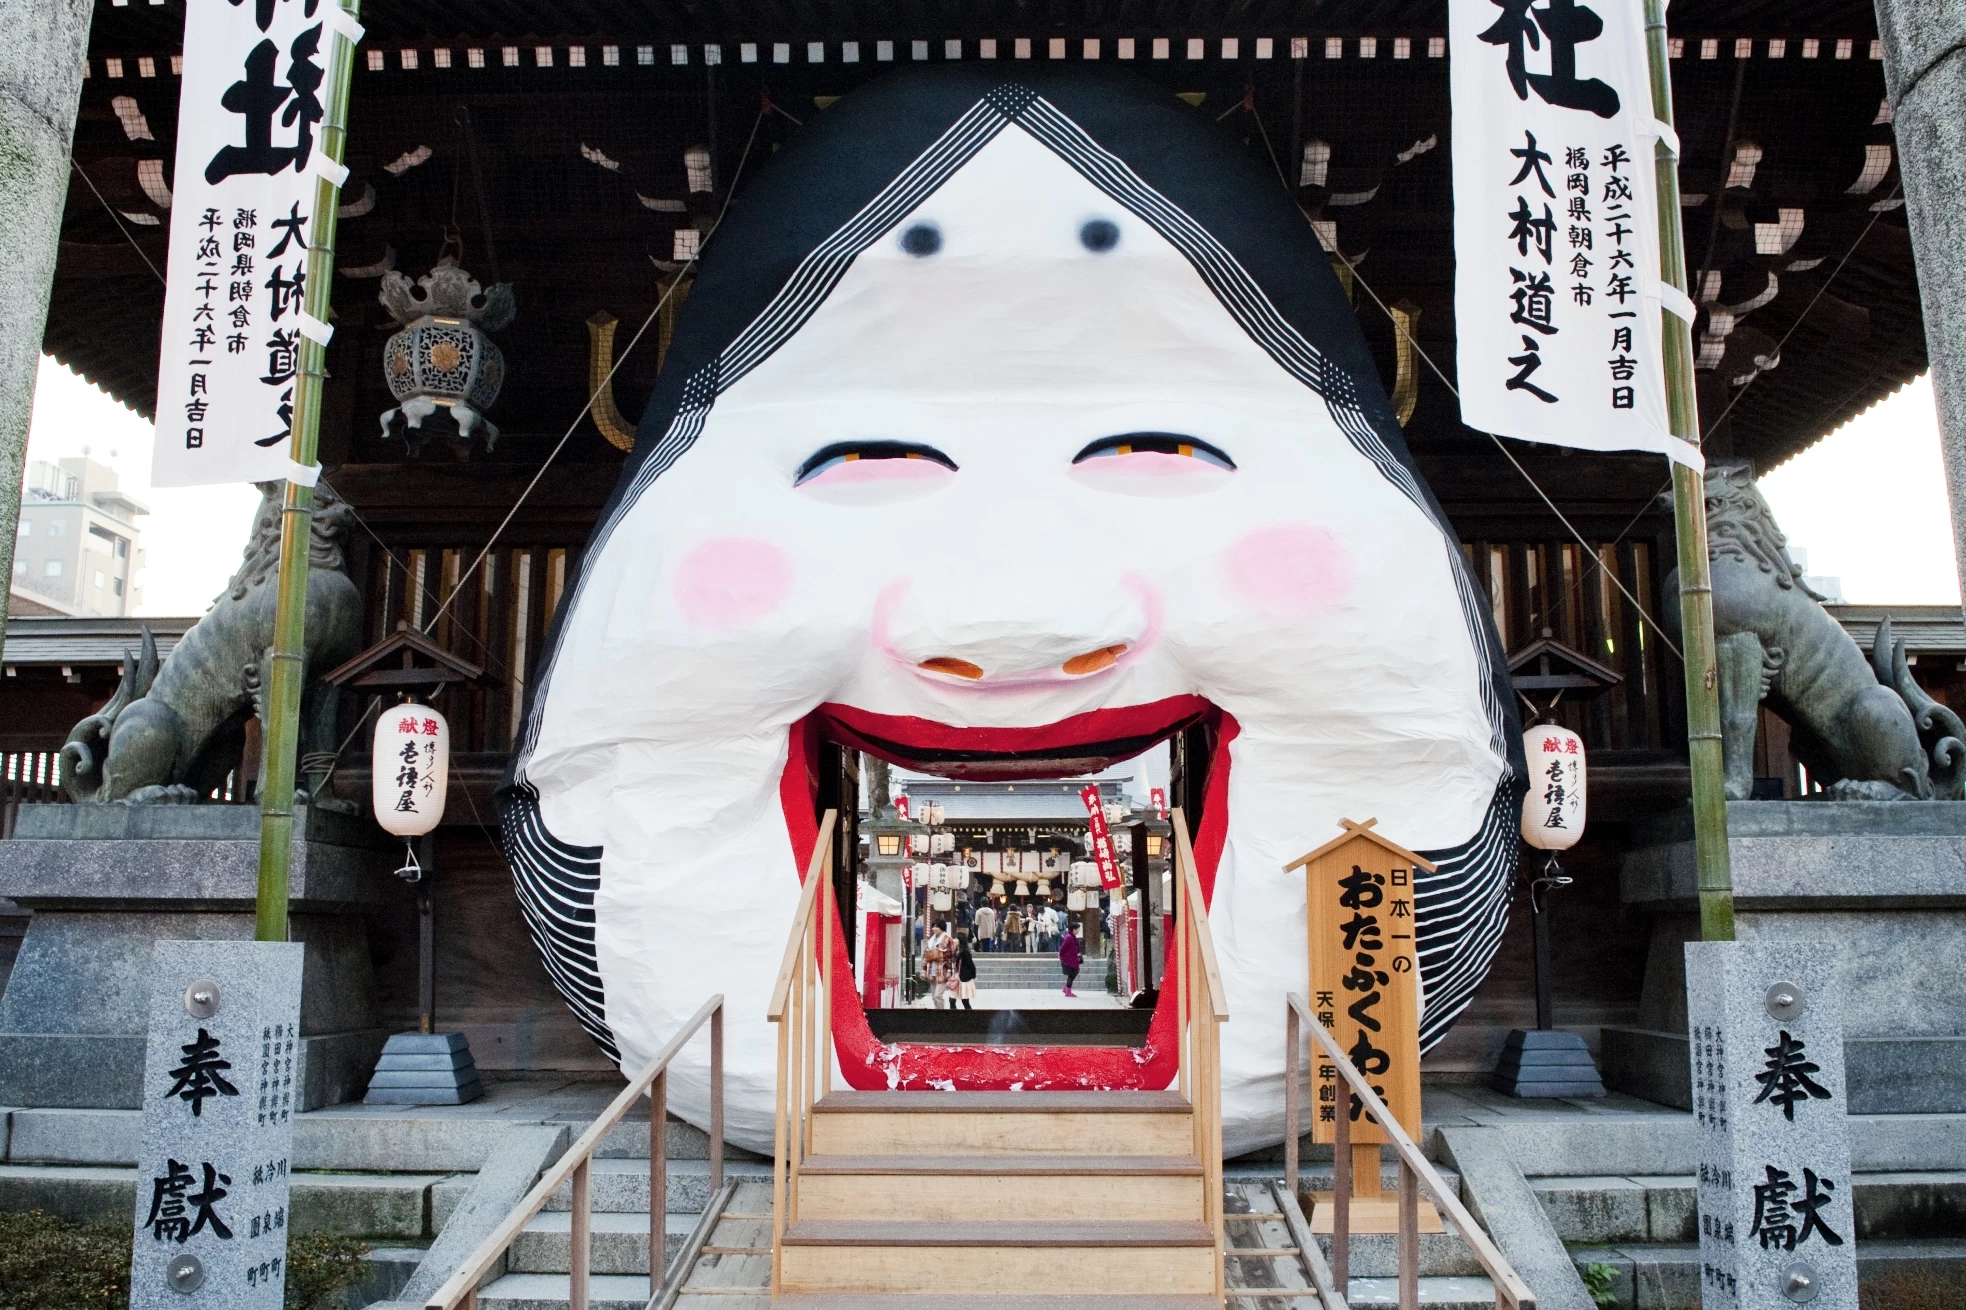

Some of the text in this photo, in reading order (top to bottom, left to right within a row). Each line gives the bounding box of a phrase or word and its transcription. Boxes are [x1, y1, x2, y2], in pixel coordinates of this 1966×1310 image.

[1477, 0, 1621, 119] 社
[1506, 129, 1559, 404] 大村道之
[1565, 146, 1595, 307] 福岡県朝倉市
[1600, 144, 1638, 409] 平成二十六年一月吉日
[1390, 869, 1412, 974] 日本一の
[1316, 991, 1336, 1123] 天保一年創業
